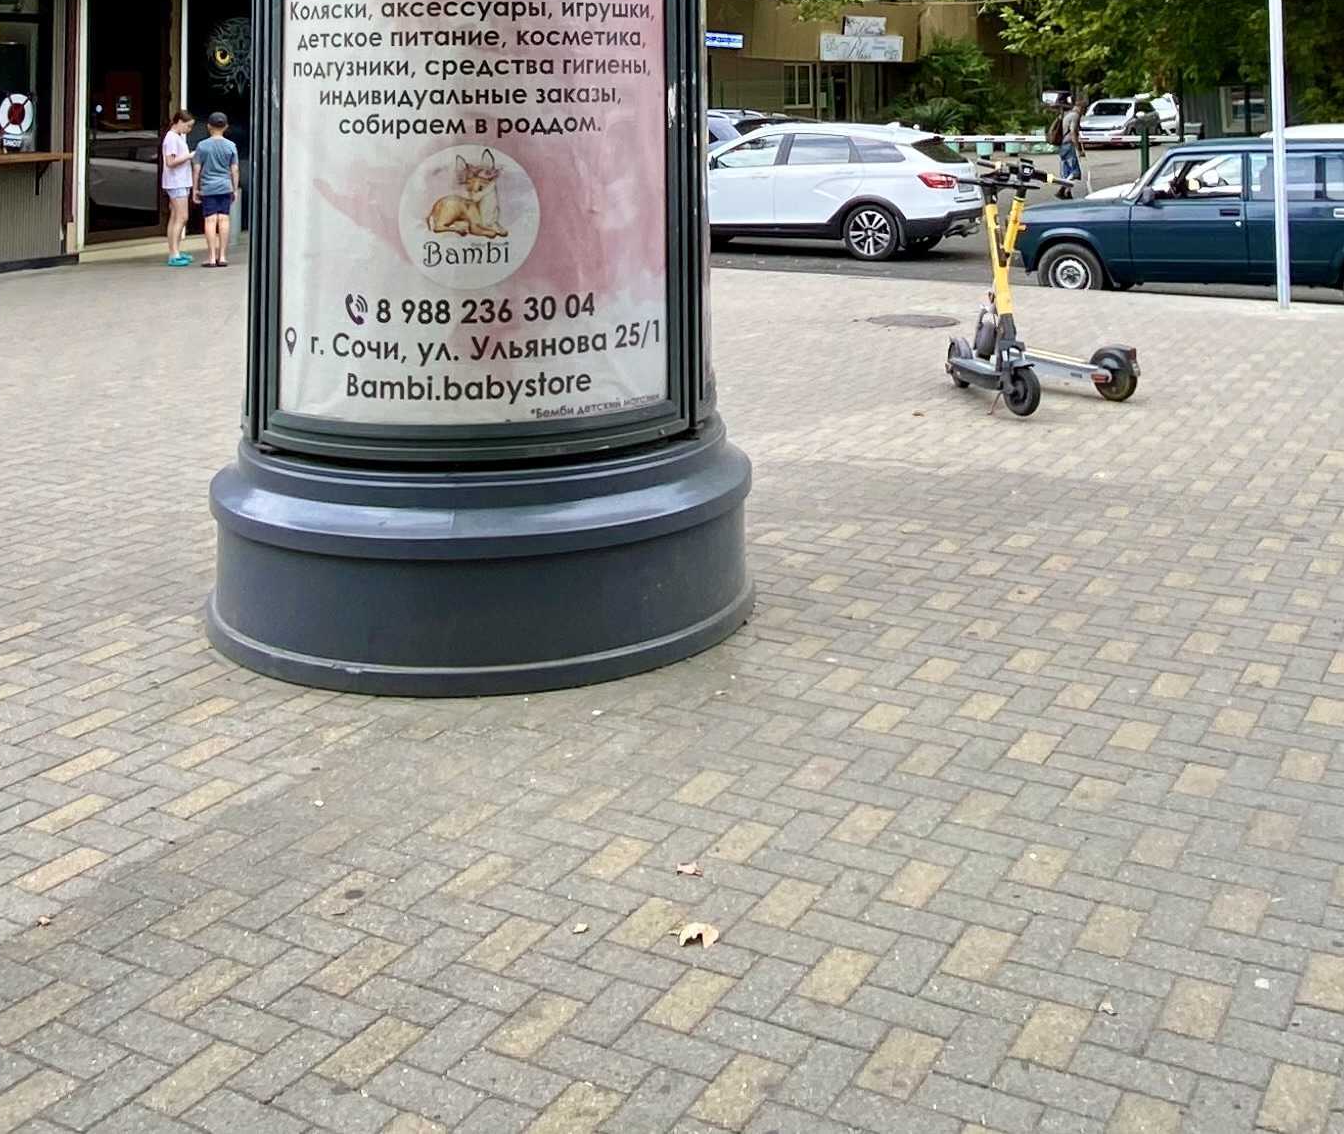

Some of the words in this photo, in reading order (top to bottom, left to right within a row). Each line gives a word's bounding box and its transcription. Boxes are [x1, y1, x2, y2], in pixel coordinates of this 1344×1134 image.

[290, 1, 372, 21] Коляски,
[381, 1, 552, 21] аксессуары,
[562, 2, 655, 22] игрушки,
[297, 31, 382, 51] детское
[391, 29, 507, 48] питание,
[517, 30, 646, 48] косметика,
[293, 60, 416, 81] подгузники,
[425, 59, 553, 80] средства
[563, 59, 651, 76] гигиены,
[319, 88, 527, 110] индивидуальные
[536, 88, 621, 104] заказы,
[339, 114, 466, 139] собираем
[475, 119, 487, 134] в
[497, 117, 601, 138] роддом.
[423, 241, 509, 267] Bambi
[376, 299, 391, 323] 8
[402, 299, 450, 324] 988
[460, 299, 512, 324] 236
[523, 296, 556, 321] 30
[565, 292, 594, 318] 04
[311, 336, 324, 355] г.
[332, 333, 406, 363] Сочи,
[418, 342, 459, 367] ул.
[470, 332, 607, 360] Ульянова
[615, 319, 660, 348] 25/1
[346, 372, 592, 405] Bambi.babystore
